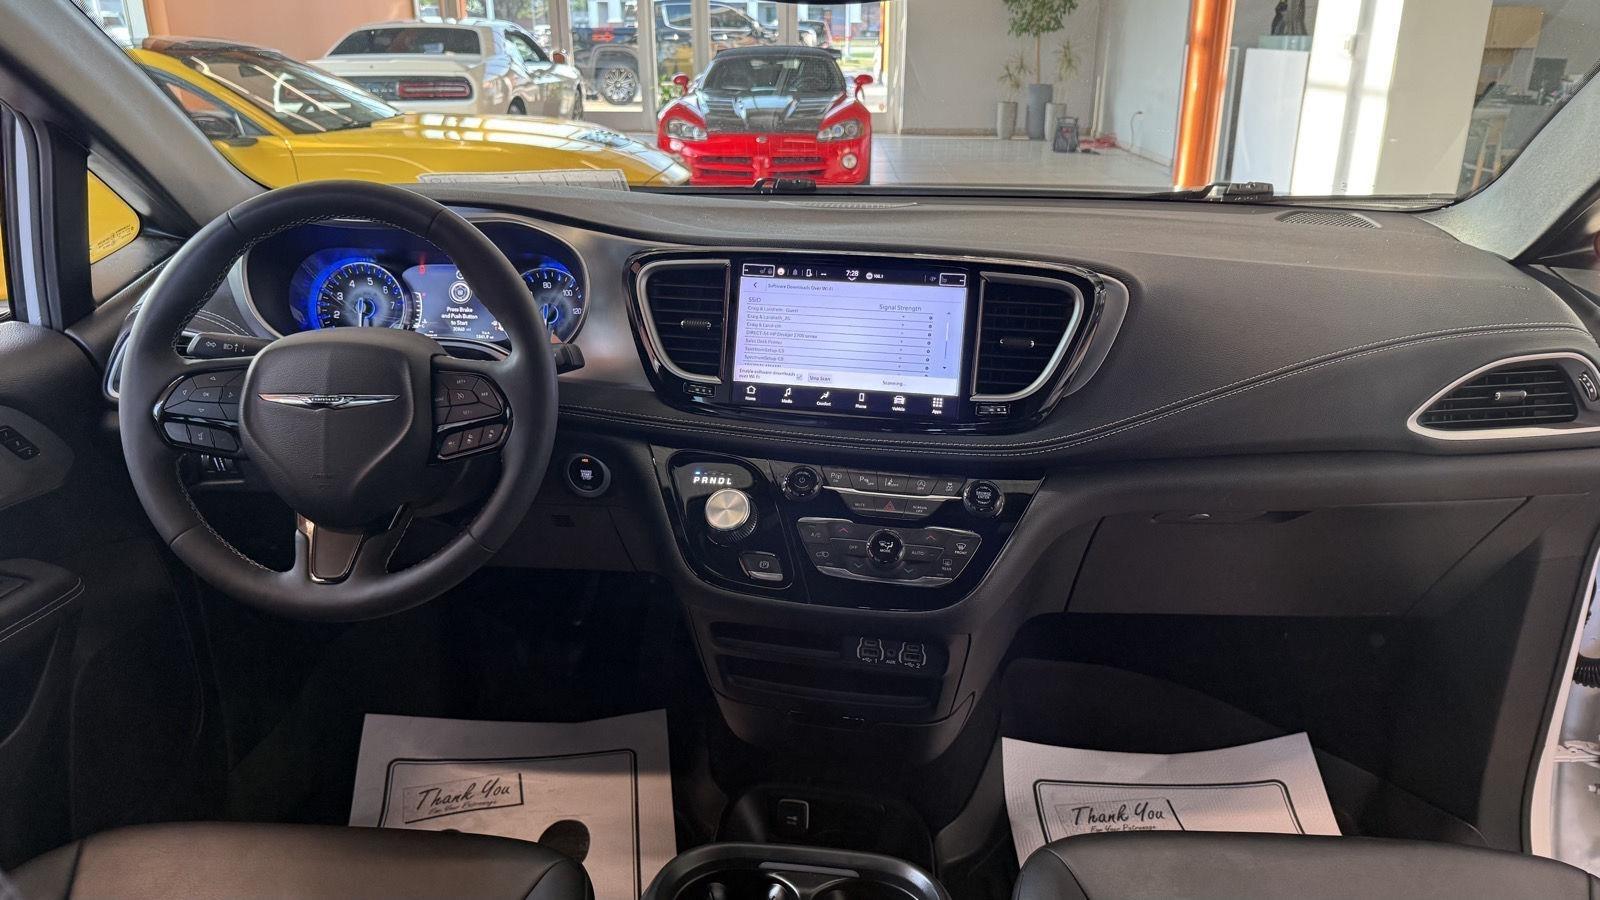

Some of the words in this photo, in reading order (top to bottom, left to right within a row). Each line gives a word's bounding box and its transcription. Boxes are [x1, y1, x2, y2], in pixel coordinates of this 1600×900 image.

[349, 280, 355, 288] 4
[367, 278, 373, 286] 5
[383, 286, 388, 294] 6
[336, 292, 343, 300] 3
[390, 302, 395, 310] 7
[880, 304, 896, 312] Signal
[333, 310, 340, 319] 2
[417, 783, 476, 810] Thank
[482, 777, 511, 798] You
[1072, 804, 1129, 825] Thank
[1135, 801, 1165, 821] You
